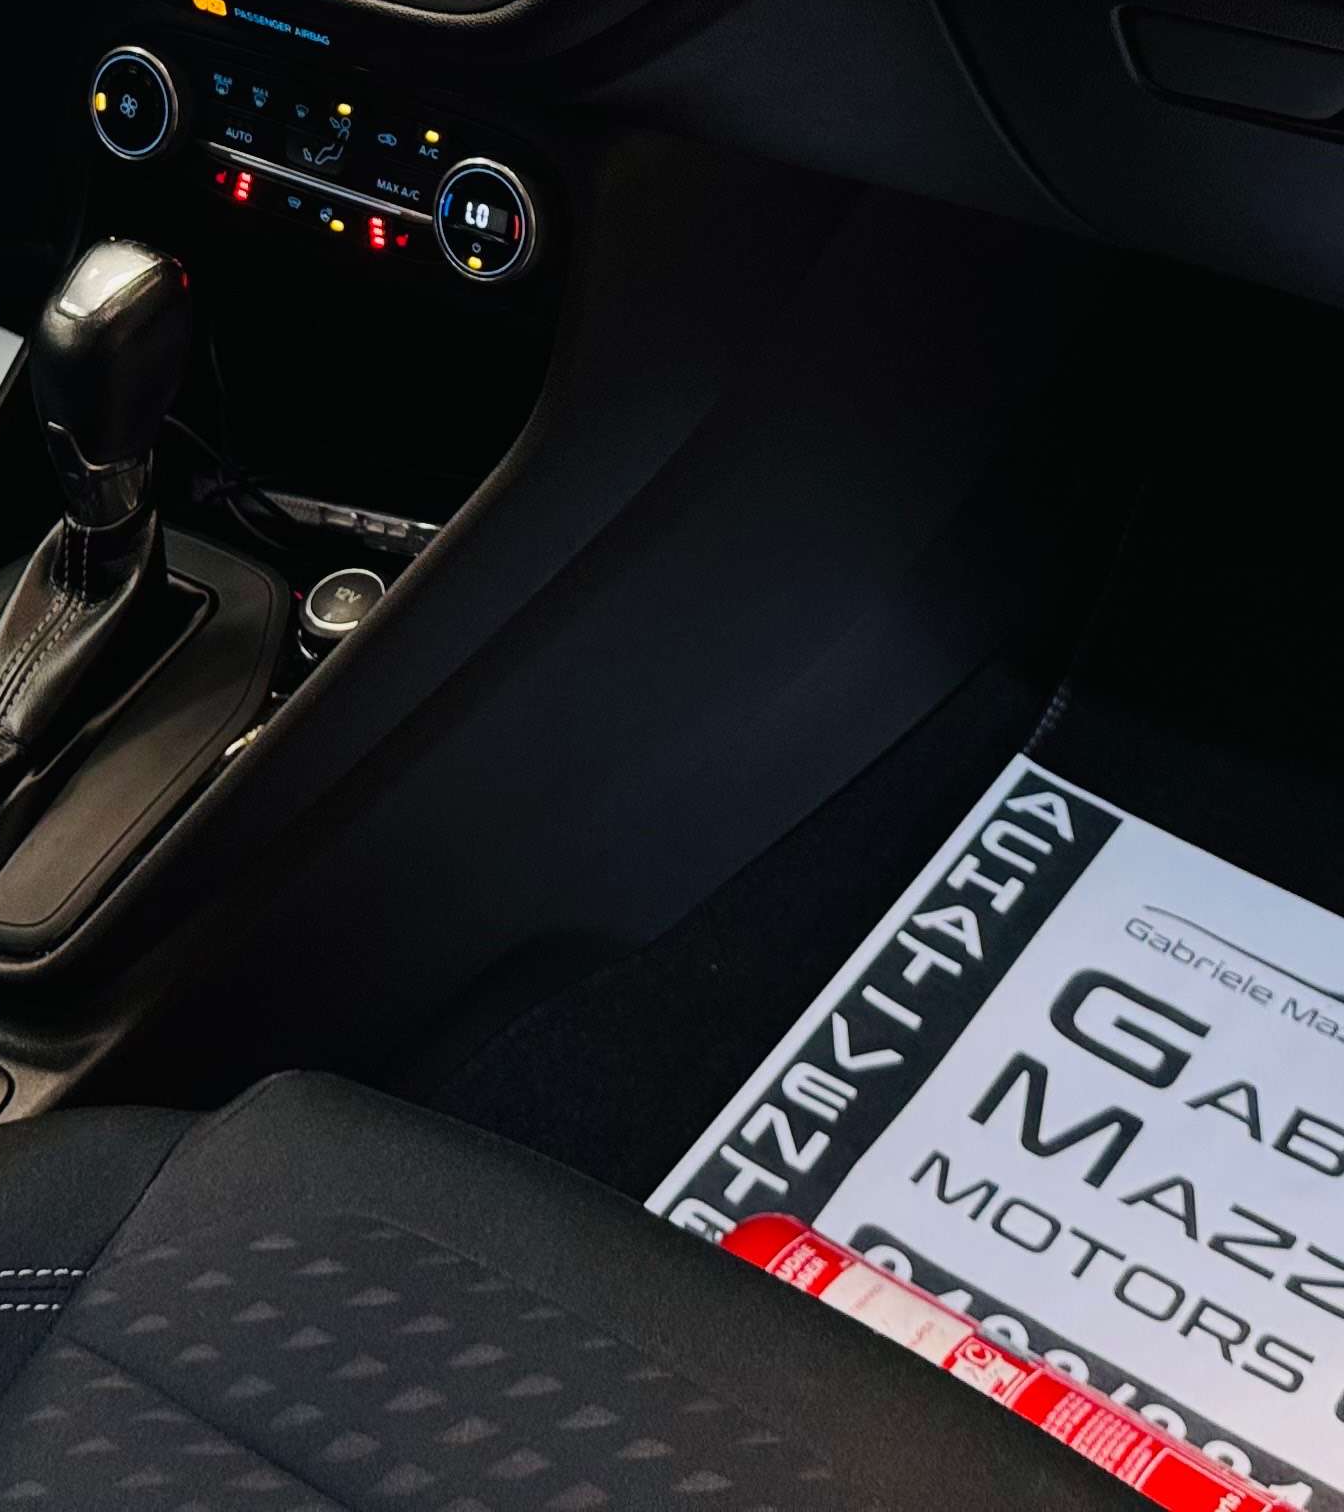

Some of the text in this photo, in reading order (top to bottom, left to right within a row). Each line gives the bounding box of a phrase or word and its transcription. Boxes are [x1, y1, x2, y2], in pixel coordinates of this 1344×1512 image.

[234, 7, 330, 46] PASSENGER AIRBAG
[225, 126, 253, 145] AUTO
[419, 145, 439, 160] A/C
[376, 178, 420, 201] MAX A/C
[1124, 917, 1273, 1005] Gabriele
[910, 1149, 1315, 1393] MOTORS
